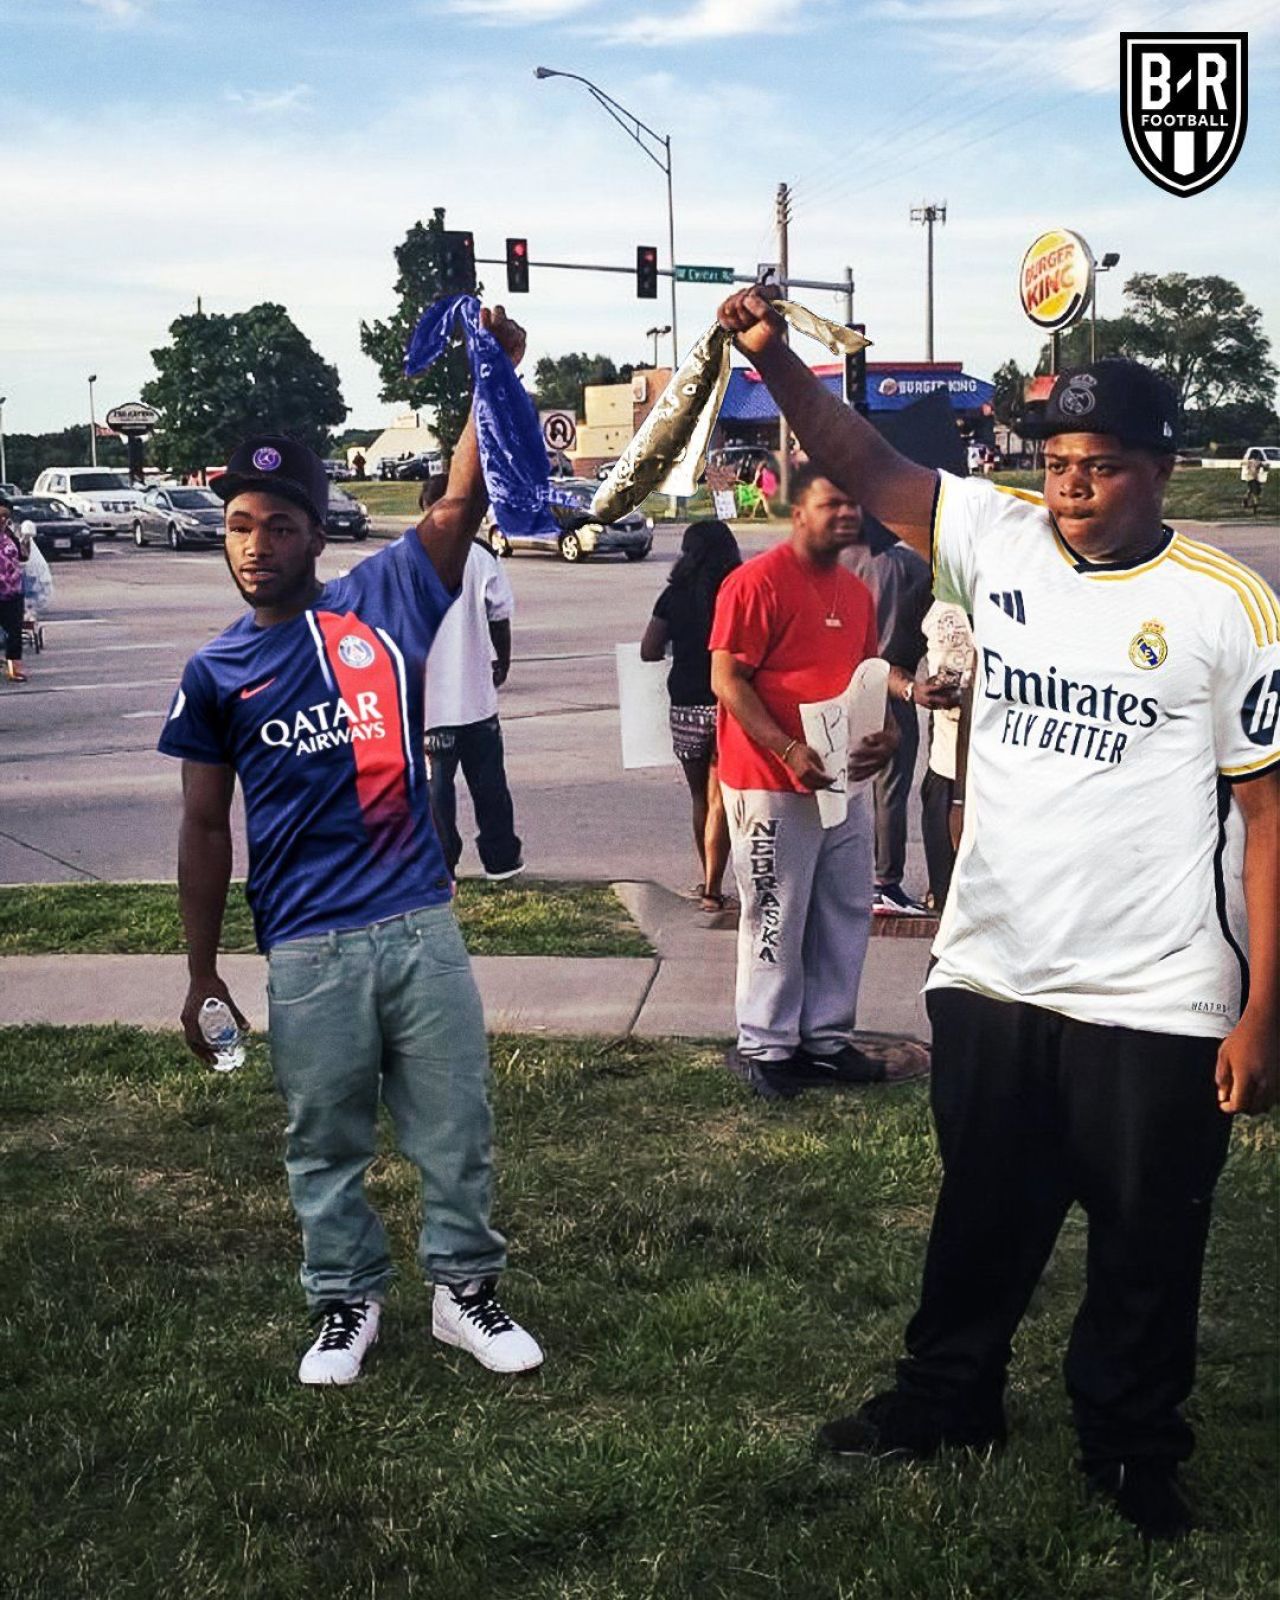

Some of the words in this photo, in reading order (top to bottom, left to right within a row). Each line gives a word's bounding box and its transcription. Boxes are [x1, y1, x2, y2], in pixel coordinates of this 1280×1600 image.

[1025, 243, 1075, 288] BURGER
[1027, 262, 1075, 312] KING
[947, 379, 978, 393] KING
[982, 646, 1159, 729] Emirates
[260, 690, 383, 748] QATAR
[295, 720, 386, 756] AIRWAYS
[1001, 708, 1037, 747] FLY
[1038, 717, 1128, 765] BETTER
[750, 818, 781, 963] NEBRASKA
